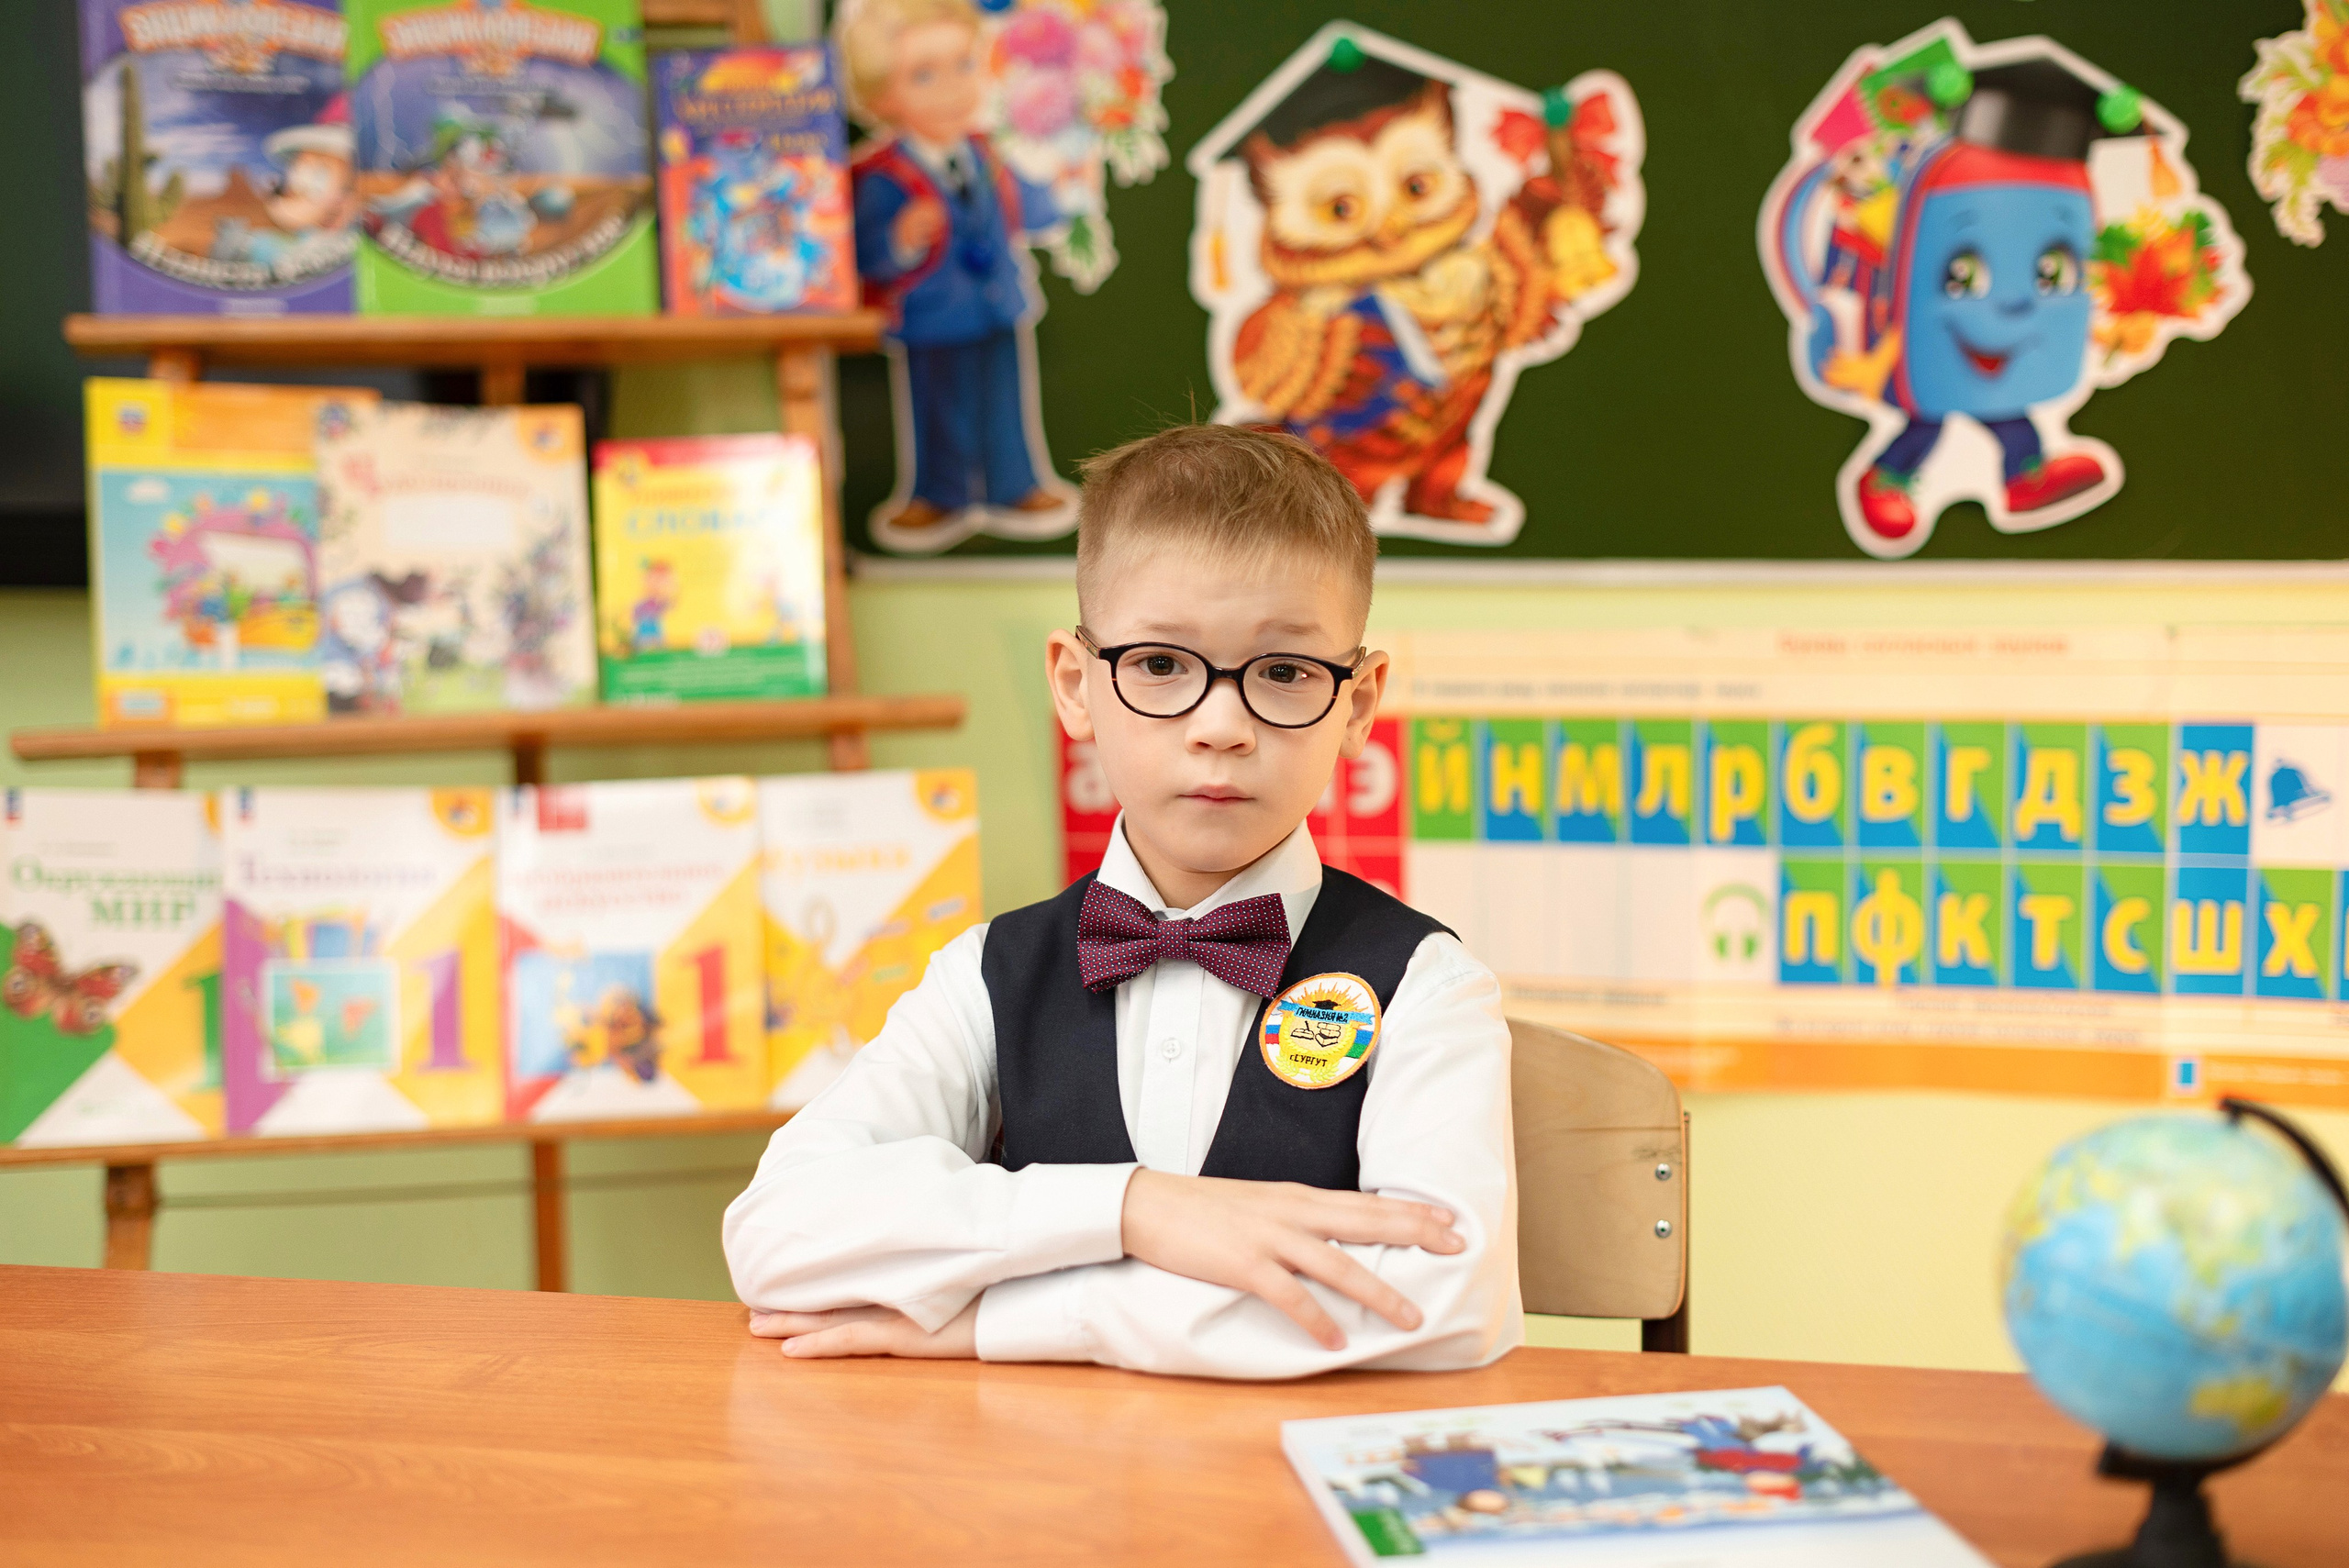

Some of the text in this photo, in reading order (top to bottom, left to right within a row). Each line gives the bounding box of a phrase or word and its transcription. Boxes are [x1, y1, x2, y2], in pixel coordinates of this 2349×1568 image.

[1417, 717, 1471, 815] й
[1490, 742, 1544, 815] н
[1554, 742, 1624, 817] м
[1637, 743, 1694, 817] л
[1709, 743, 1767, 842] р
[1783, 722, 1842, 822] б
[1860, 744, 1920, 821] в
[1946, 745, 1992, 820] г
[2014, 746, 2085, 840] д
[2104, 747, 2159, 826] з
[2175, 751, 2248, 827] ж
[1783, 867, 2321, 986] п ф к т с ш х
[415, 947, 479, 1073] 1
[683, 941, 747, 1066] 1
[1296, 1007, 1336, 1022] ГИМНАЗИЯ
